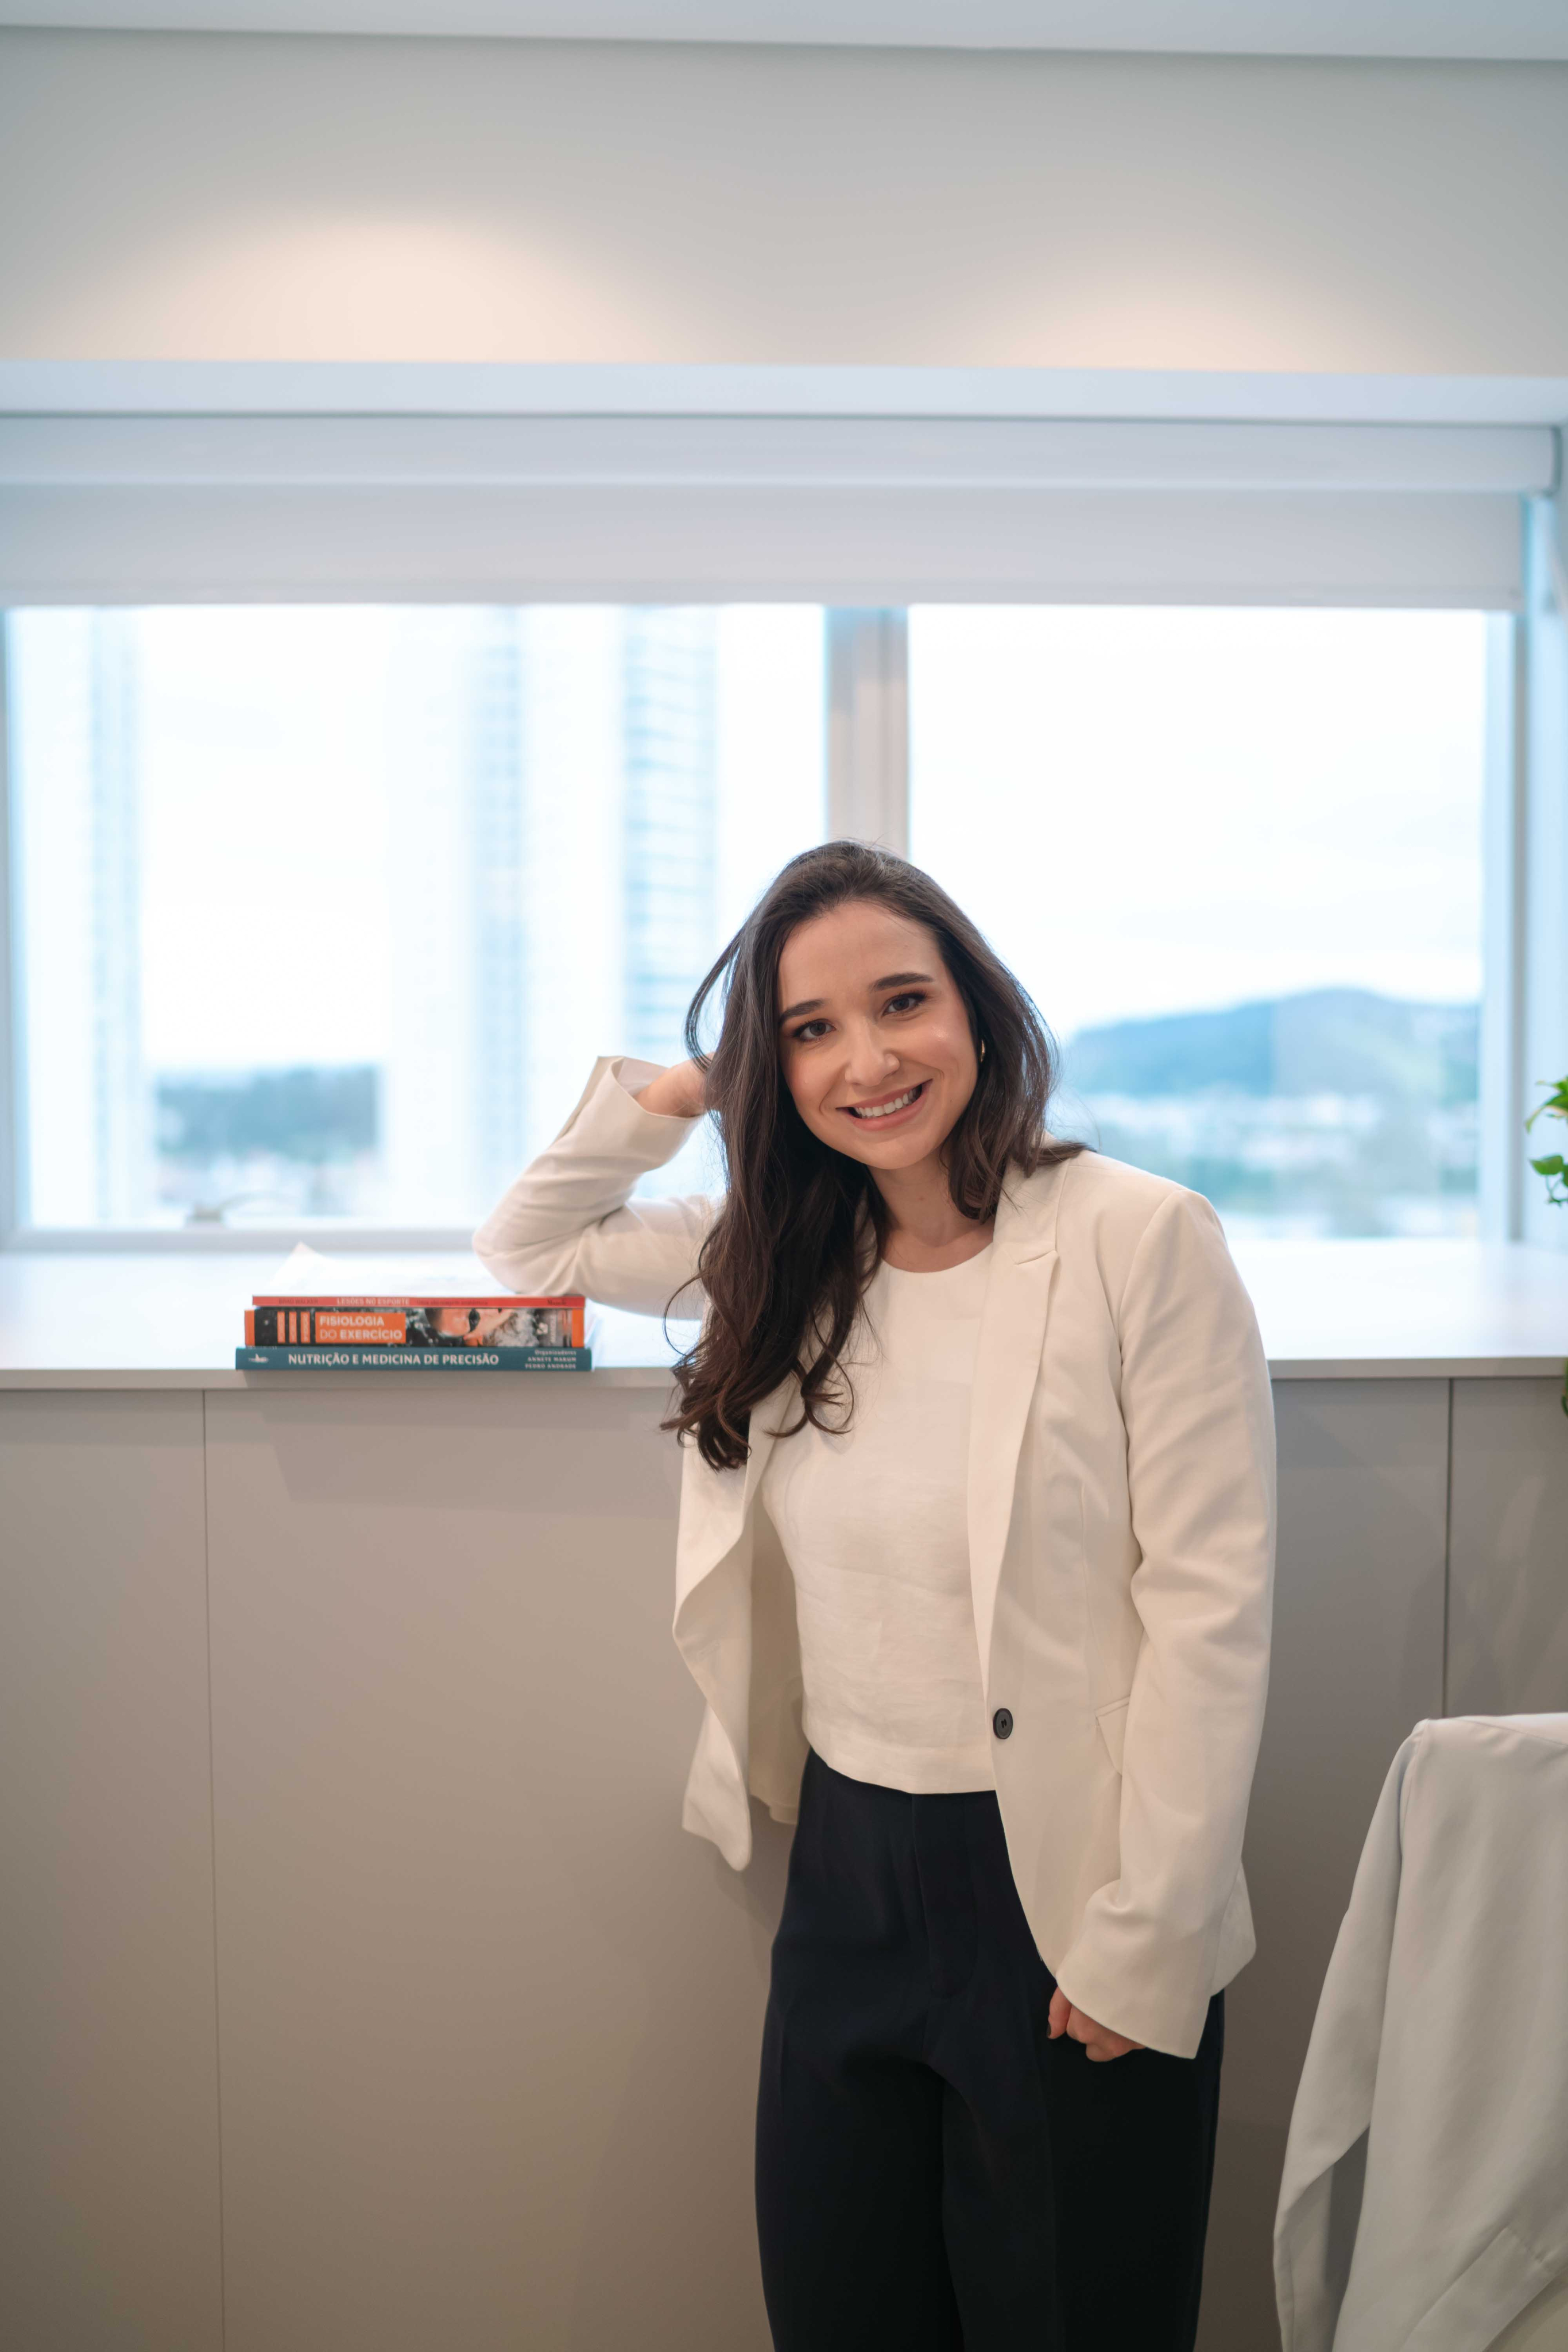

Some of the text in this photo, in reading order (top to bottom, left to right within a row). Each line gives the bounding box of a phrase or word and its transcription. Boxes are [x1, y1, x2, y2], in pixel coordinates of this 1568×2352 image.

[320, 1316, 385, 1326] FISIOLOGIA
[320, 1327, 402, 1340] DO EXERCÍCIO
[288, 1352, 499, 1366] NUTRIÇÃO E MEDICINA DE PRECISÃO
